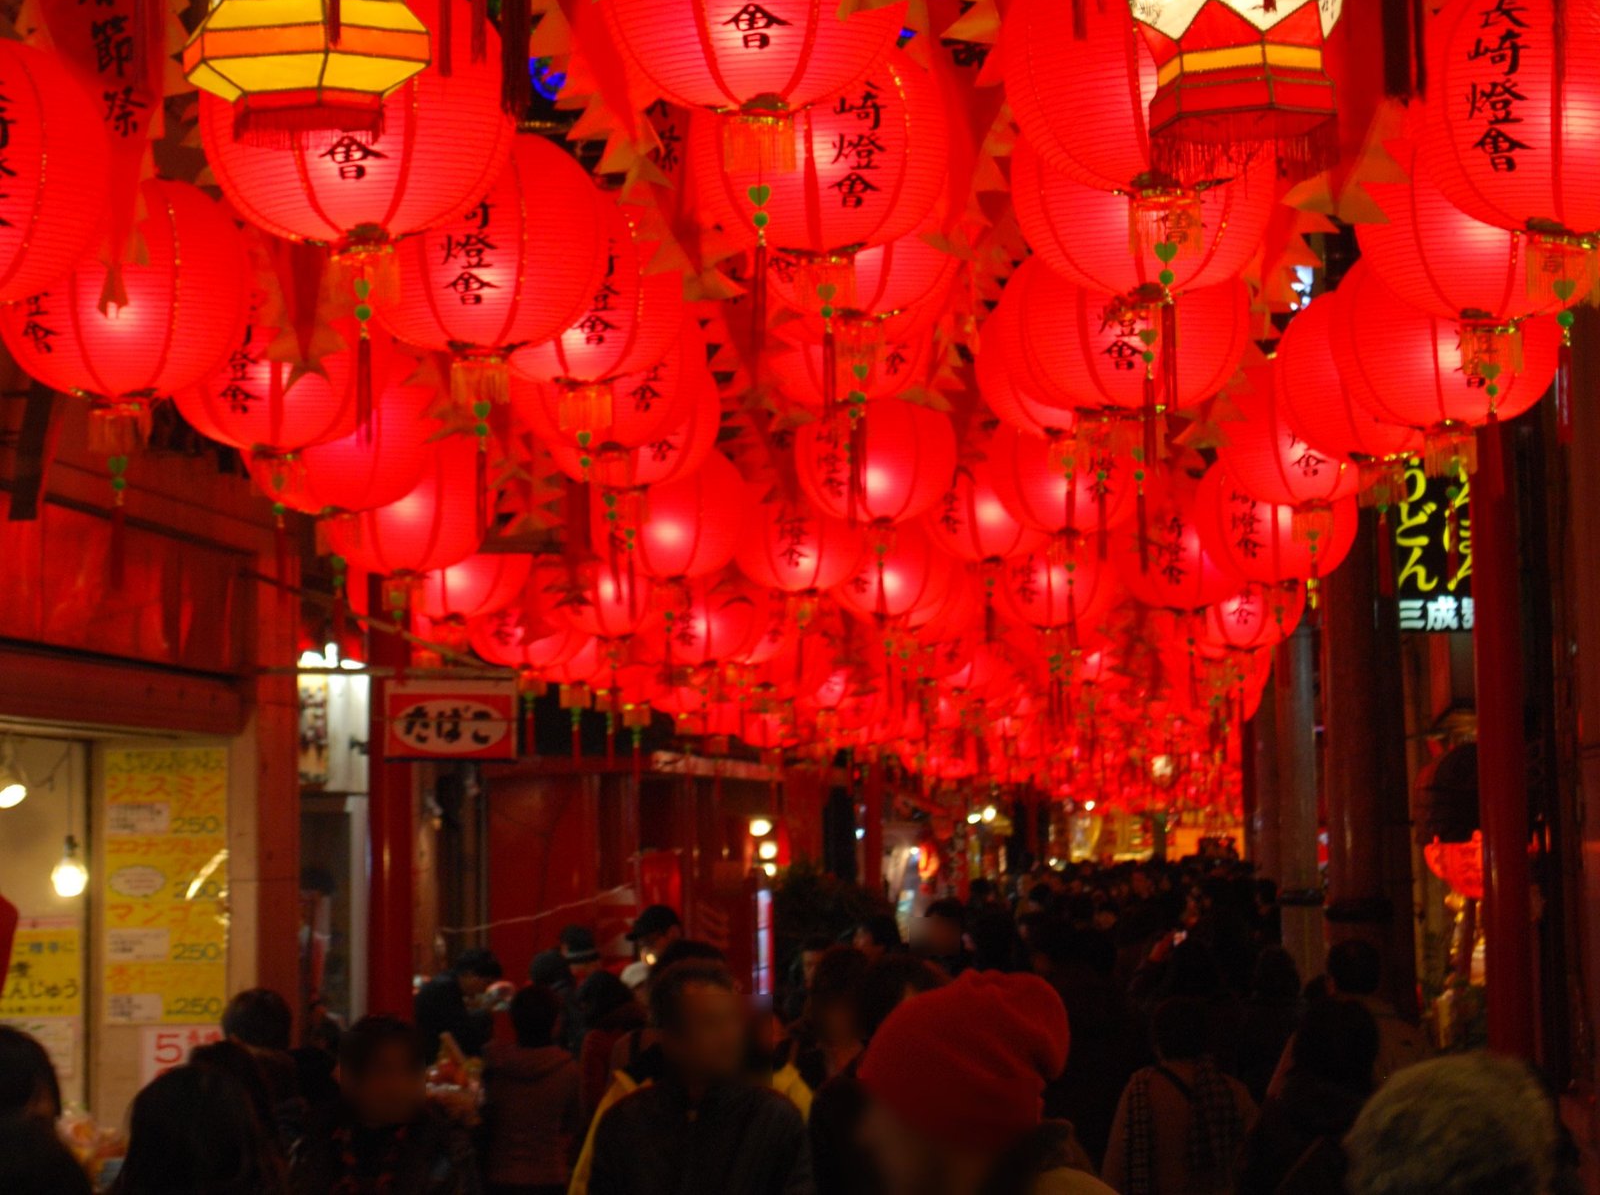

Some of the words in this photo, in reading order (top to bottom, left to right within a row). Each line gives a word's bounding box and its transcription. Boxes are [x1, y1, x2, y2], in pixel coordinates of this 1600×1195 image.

[318, 135, 390, 180] 會
[1398, 458, 1439, 592] うどん
[404, 706, 492, 745] たばこ
[172, 815, 221, 835] 250
[172, 942, 222, 962] 250
[0, 979, 78, 1000] んじゅう
[174, 997, 222, 1018] 250
